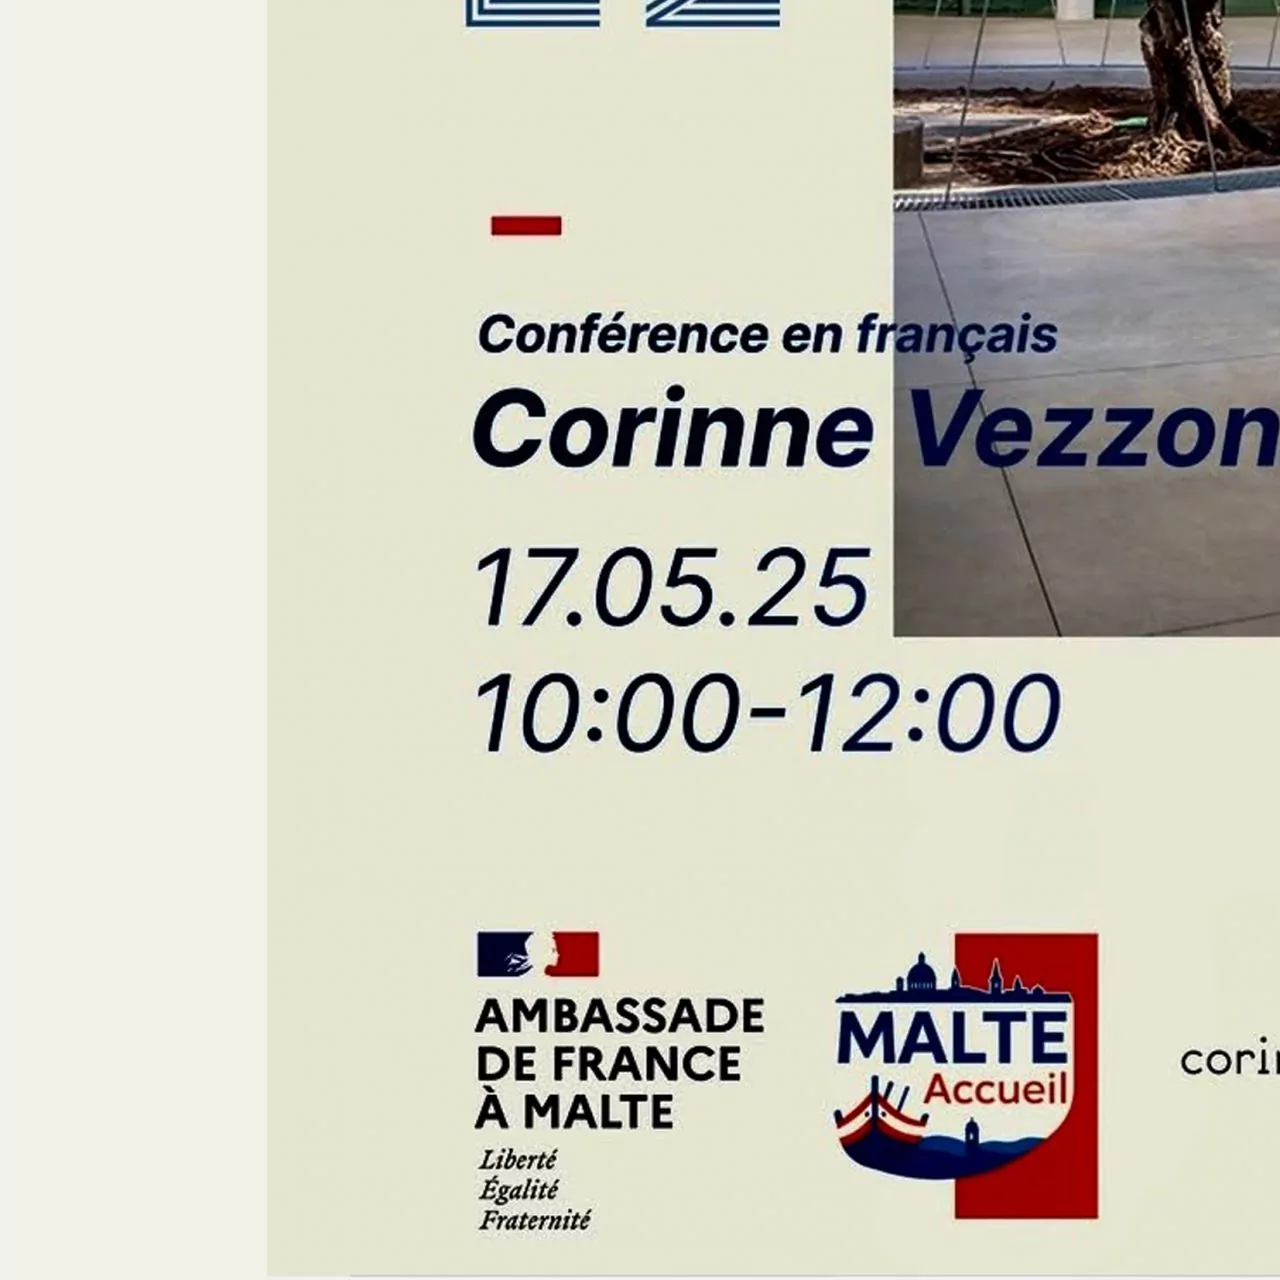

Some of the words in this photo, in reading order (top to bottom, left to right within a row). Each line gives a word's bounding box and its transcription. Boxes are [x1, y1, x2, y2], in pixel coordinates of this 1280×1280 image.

[479, 311, 769, 353] Conférence
[782, 323, 842, 353] en
[857, 312, 1058, 364] français
[473, 384, 873, 468] Corinne
[478, 547, 871, 627] 17.05.25
[478, 673, 1060, 753] 10:00-12:00
[474, 997, 764, 1034] AMBASSADE
[838, 1011, 1067, 1063] MALTE
[478, 1046, 535, 1081] DE
[554, 1046, 740, 1081] FRANCE
[475, 1086, 509, 1129] À
[525, 1094, 673, 1129] MALTE
[923, 1072, 1067, 1105] Accueil
[478, 1148, 558, 1170] Liberté
[479, 1175, 560, 1206] Égalité
[479, 1208, 592, 1231] Fraternité
